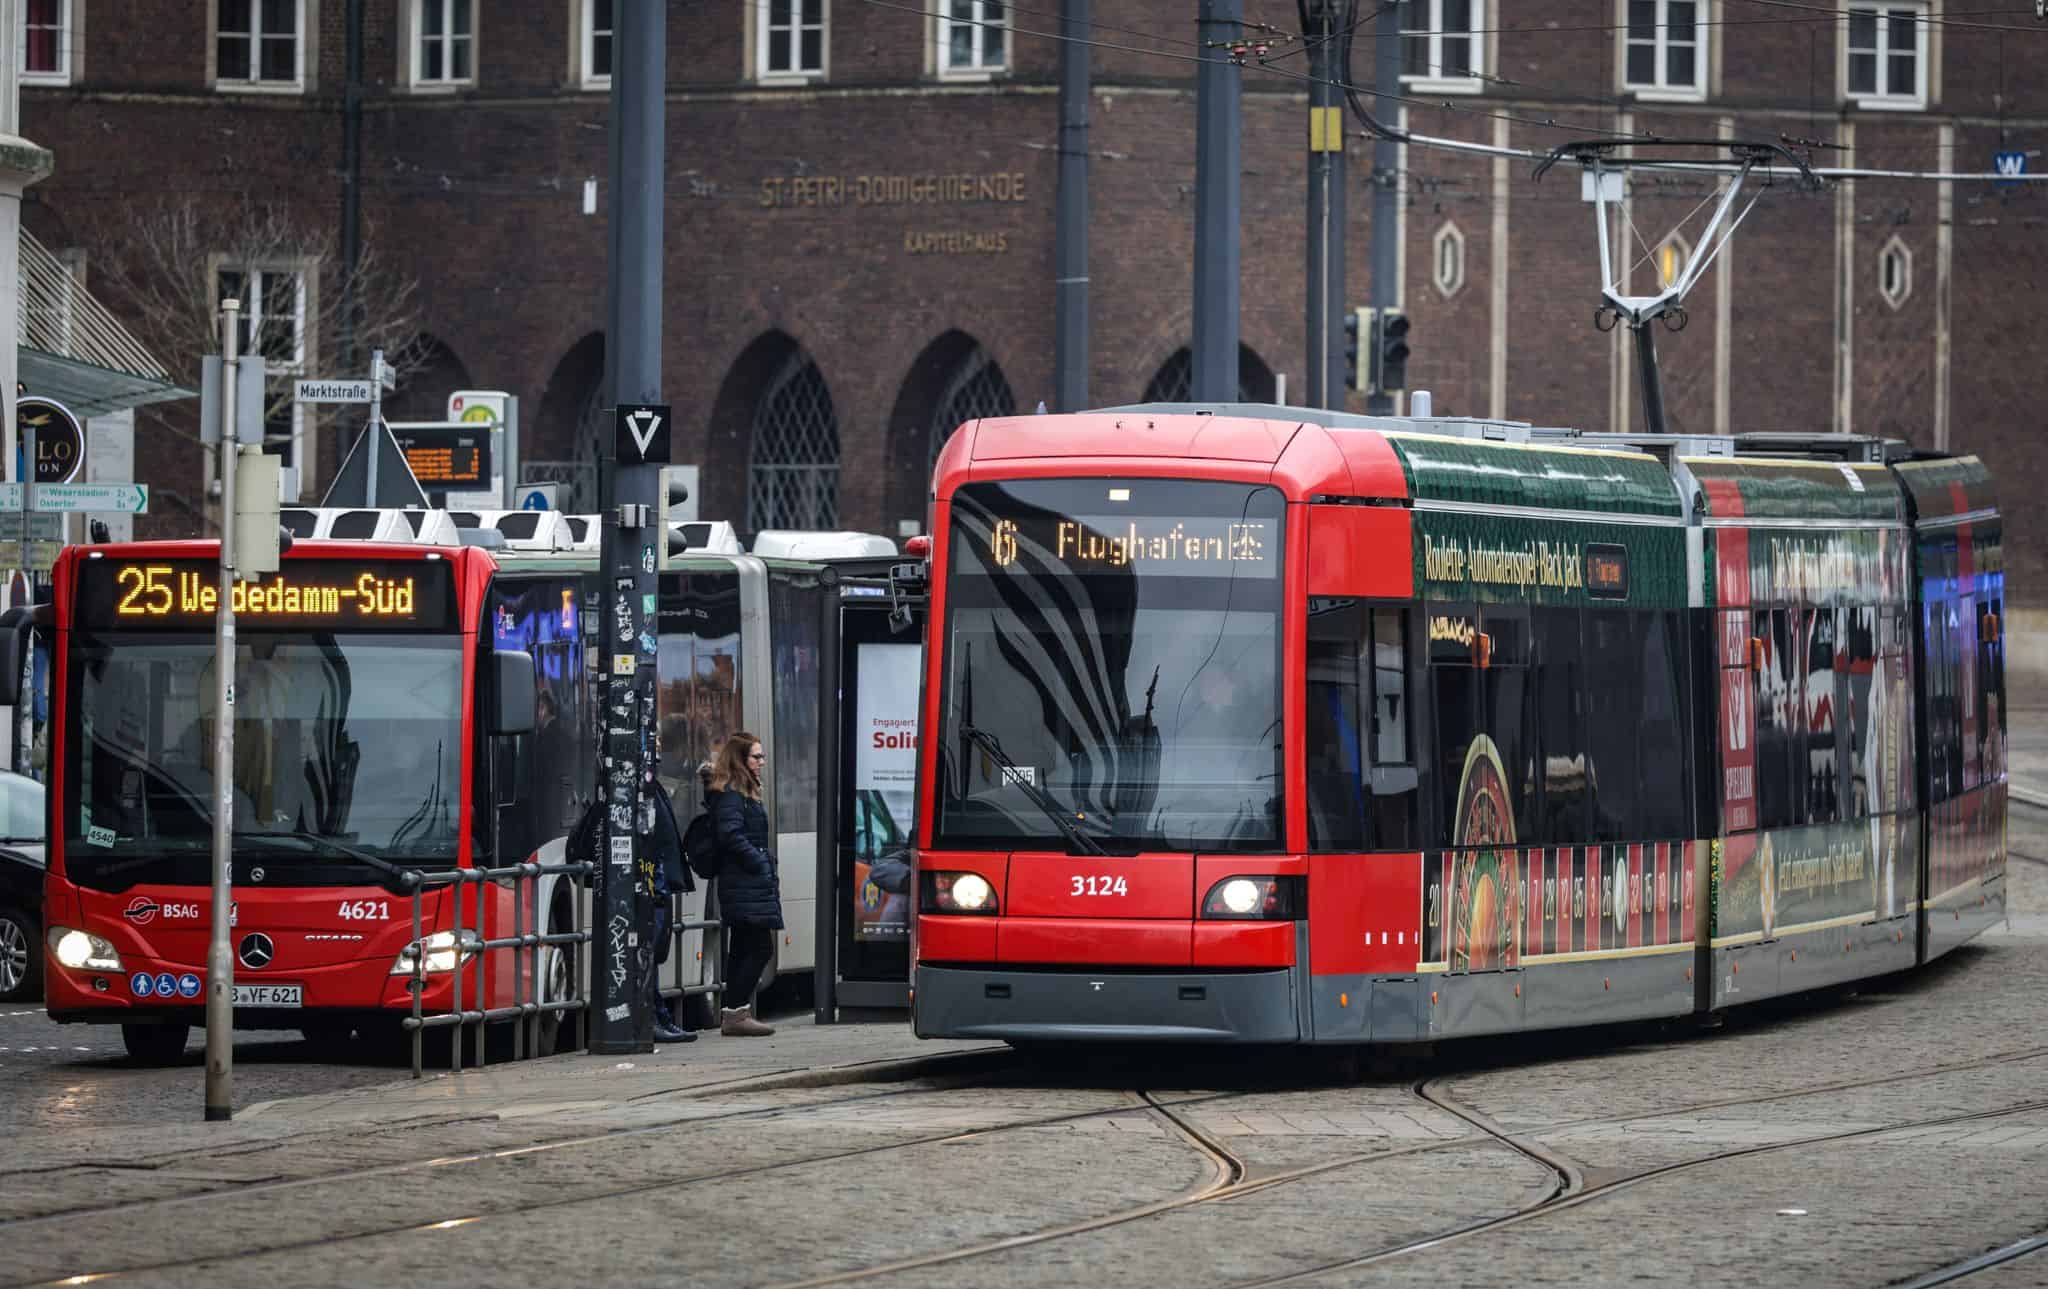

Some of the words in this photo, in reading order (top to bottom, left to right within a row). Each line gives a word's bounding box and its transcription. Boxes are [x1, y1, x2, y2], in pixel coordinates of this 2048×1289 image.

[300, 384, 367, 399] Marktstraße
[39, 441, 71, 460] LO
[1058, 522, 1224, 566] Flughafen
[118, 567, 173, 614] 25
[181, 572, 415, 614] Wededamm-Süd
[90, 830, 113, 844] 4540
[1071, 876, 1128, 897] 3124
[163, 904, 199, 918] BSAG
[338, 901, 390, 920] 4621
[250, 988, 267, 1003] YF
[271, 988, 299, 1003] 621
